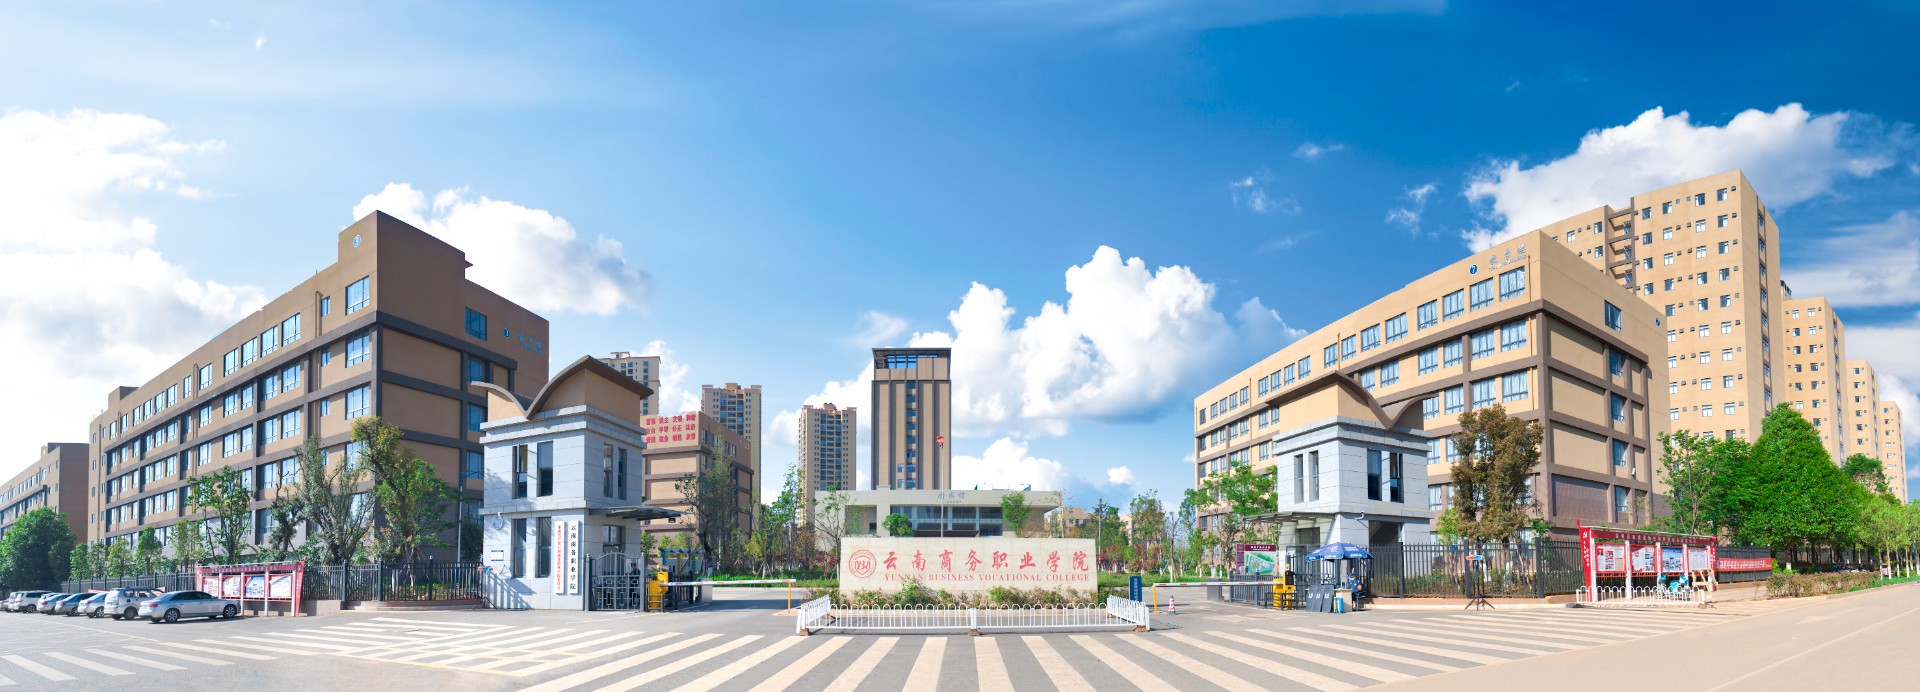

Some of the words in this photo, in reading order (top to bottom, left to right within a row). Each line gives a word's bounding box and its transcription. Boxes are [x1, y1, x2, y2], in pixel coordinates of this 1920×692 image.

[569, 524, 578, 591] 云南商务职业学院
[883, 549, 1089, 573] 云南商务职业学院
[885, 573, 924, 581] YUNNAN
[929, 573, 975, 581] BUSINESS
[979, 573, 1041, 581] VOCATIONAL
[1046, 573, 1089, 581] COLLEGE
